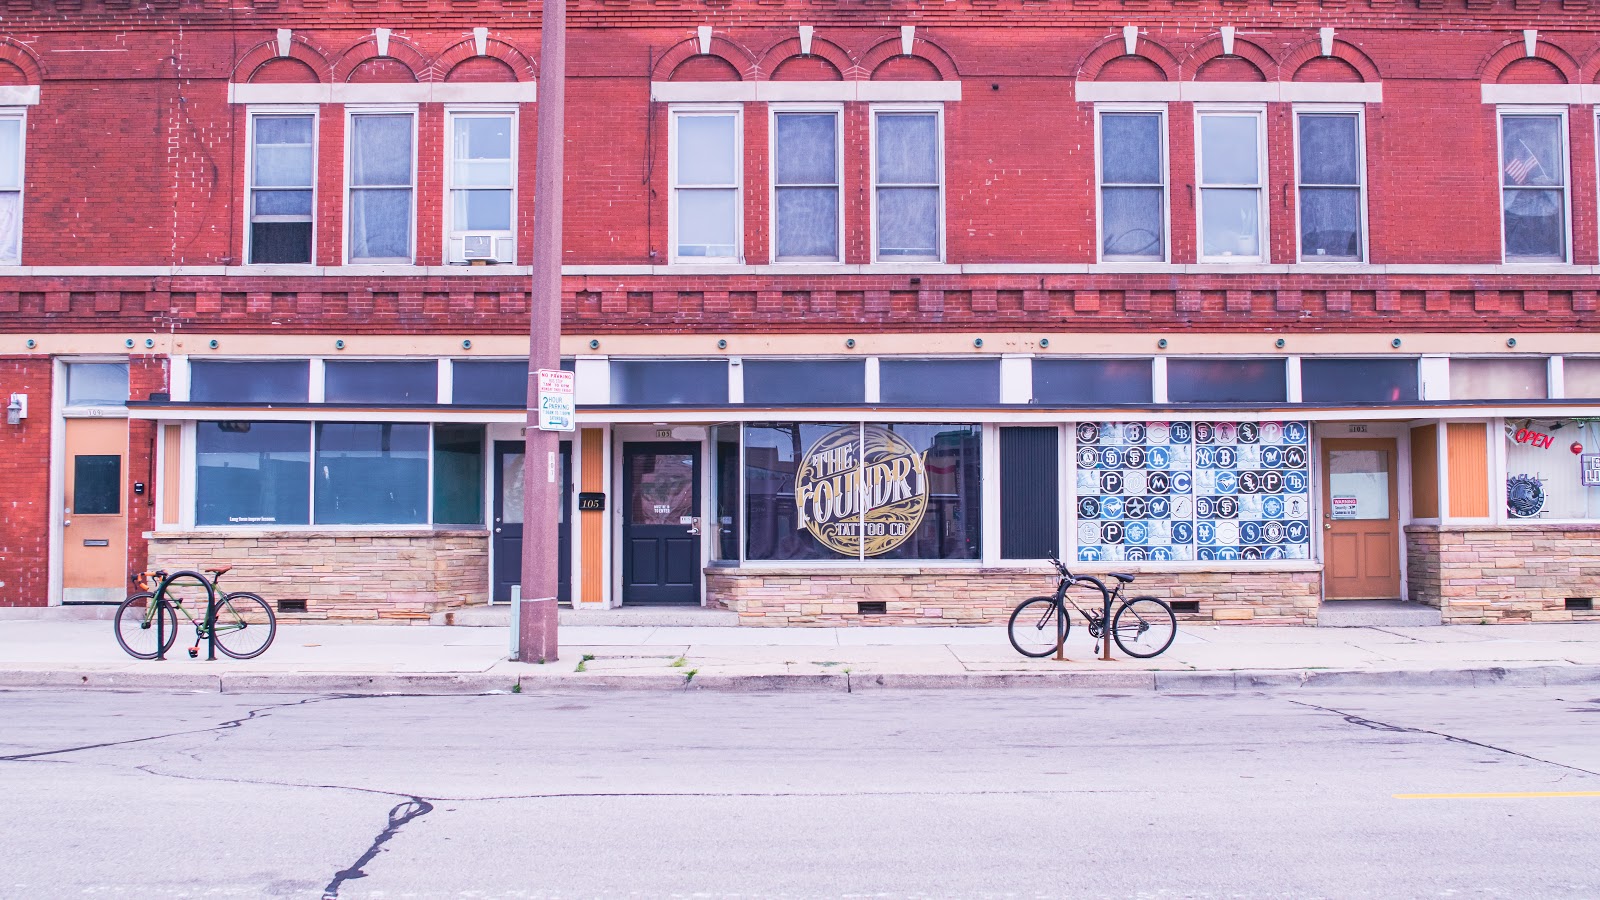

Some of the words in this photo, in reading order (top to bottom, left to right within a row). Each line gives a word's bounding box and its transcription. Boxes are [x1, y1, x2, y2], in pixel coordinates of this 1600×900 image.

[542, 396, 548, 409] 2
[1516, 428, 1554, 449] OPEN
[812, 442, 853, 479] THE
[1220, 450, 1231, 465] B
[1107, 476, 1118, 490] P
[1176, 475, 1190, 489] C
[1268, 475, 1278, 489] P
[796, 450, 928, 531] FOUNDRY
[581, 499, 599, 508] 105
[1108, 526, 1118, 539] P
[1084, 551, 1097, 561] T
[1222, 551, 1234, 560] T
